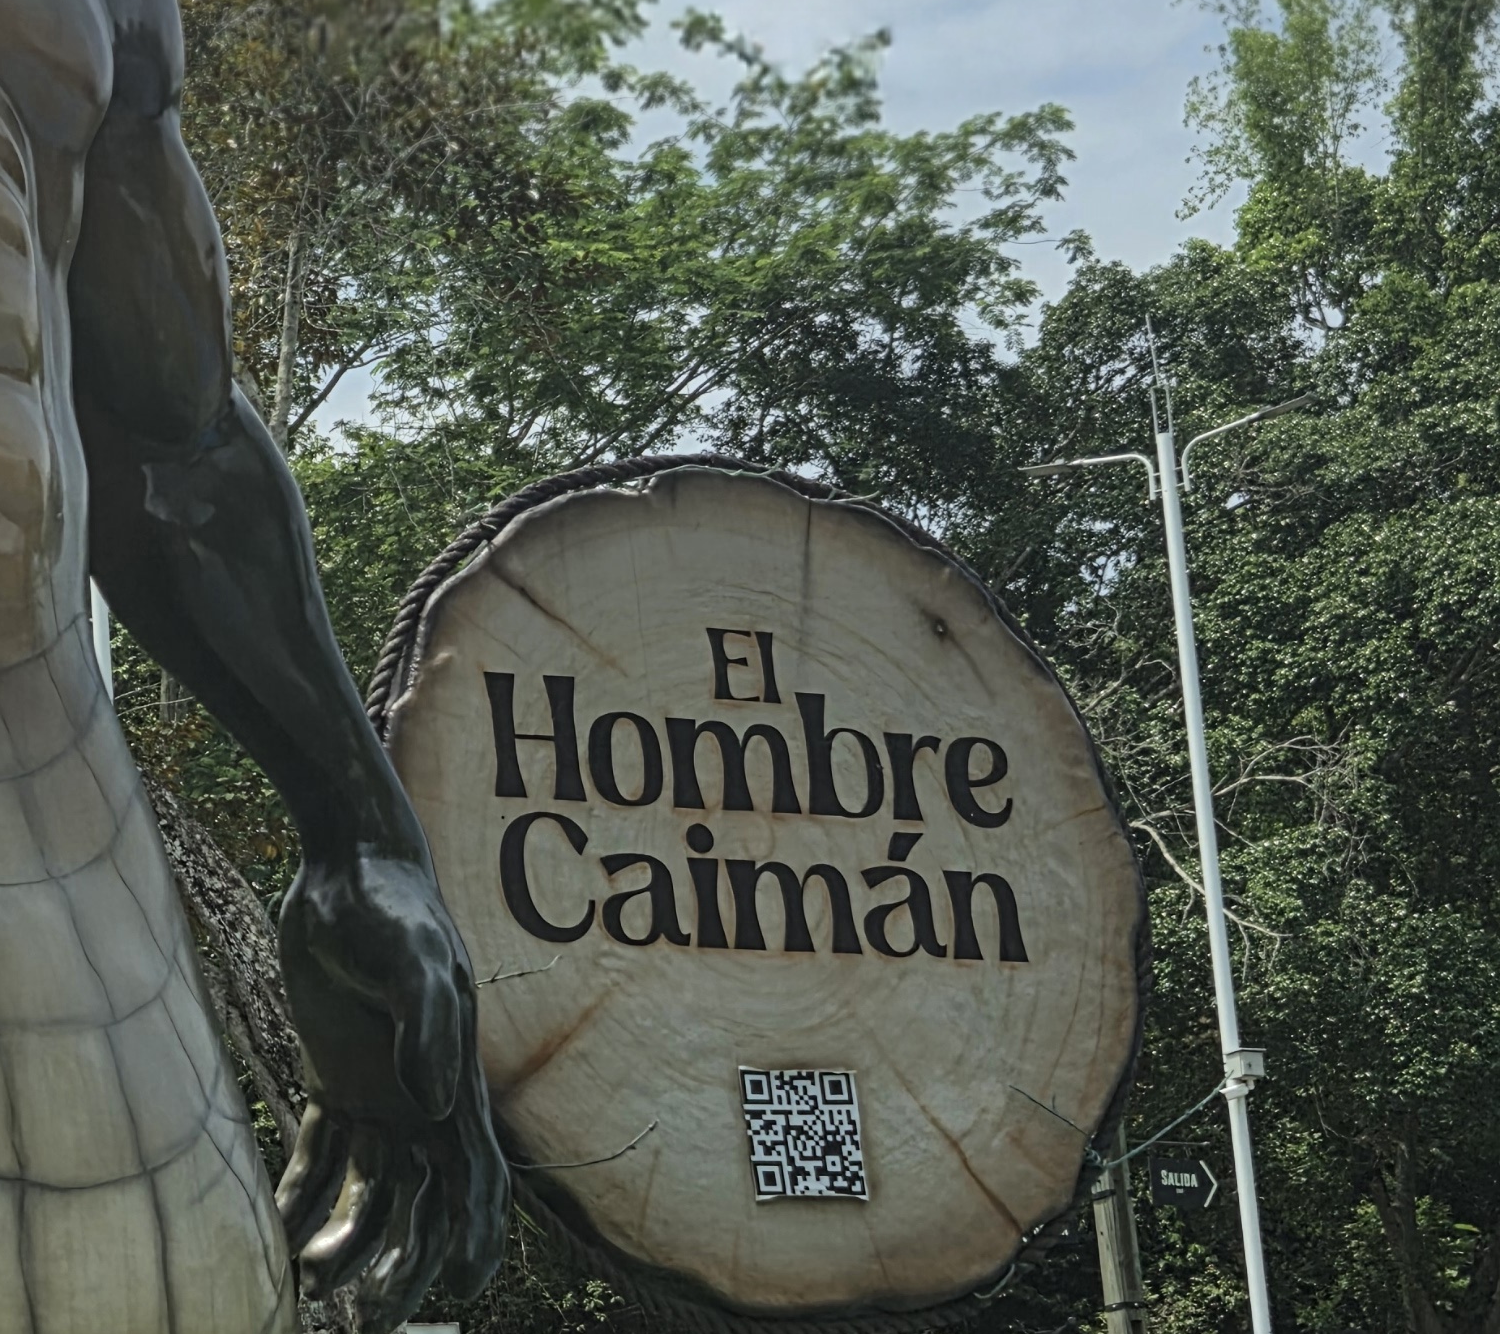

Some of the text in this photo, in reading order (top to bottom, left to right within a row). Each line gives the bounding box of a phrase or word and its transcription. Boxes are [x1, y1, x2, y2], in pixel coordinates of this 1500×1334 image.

[705, 627, 782, 705] El
[482, 671, 1014, 829] Hombre
[499, 811, 1030, 963] Caimán
